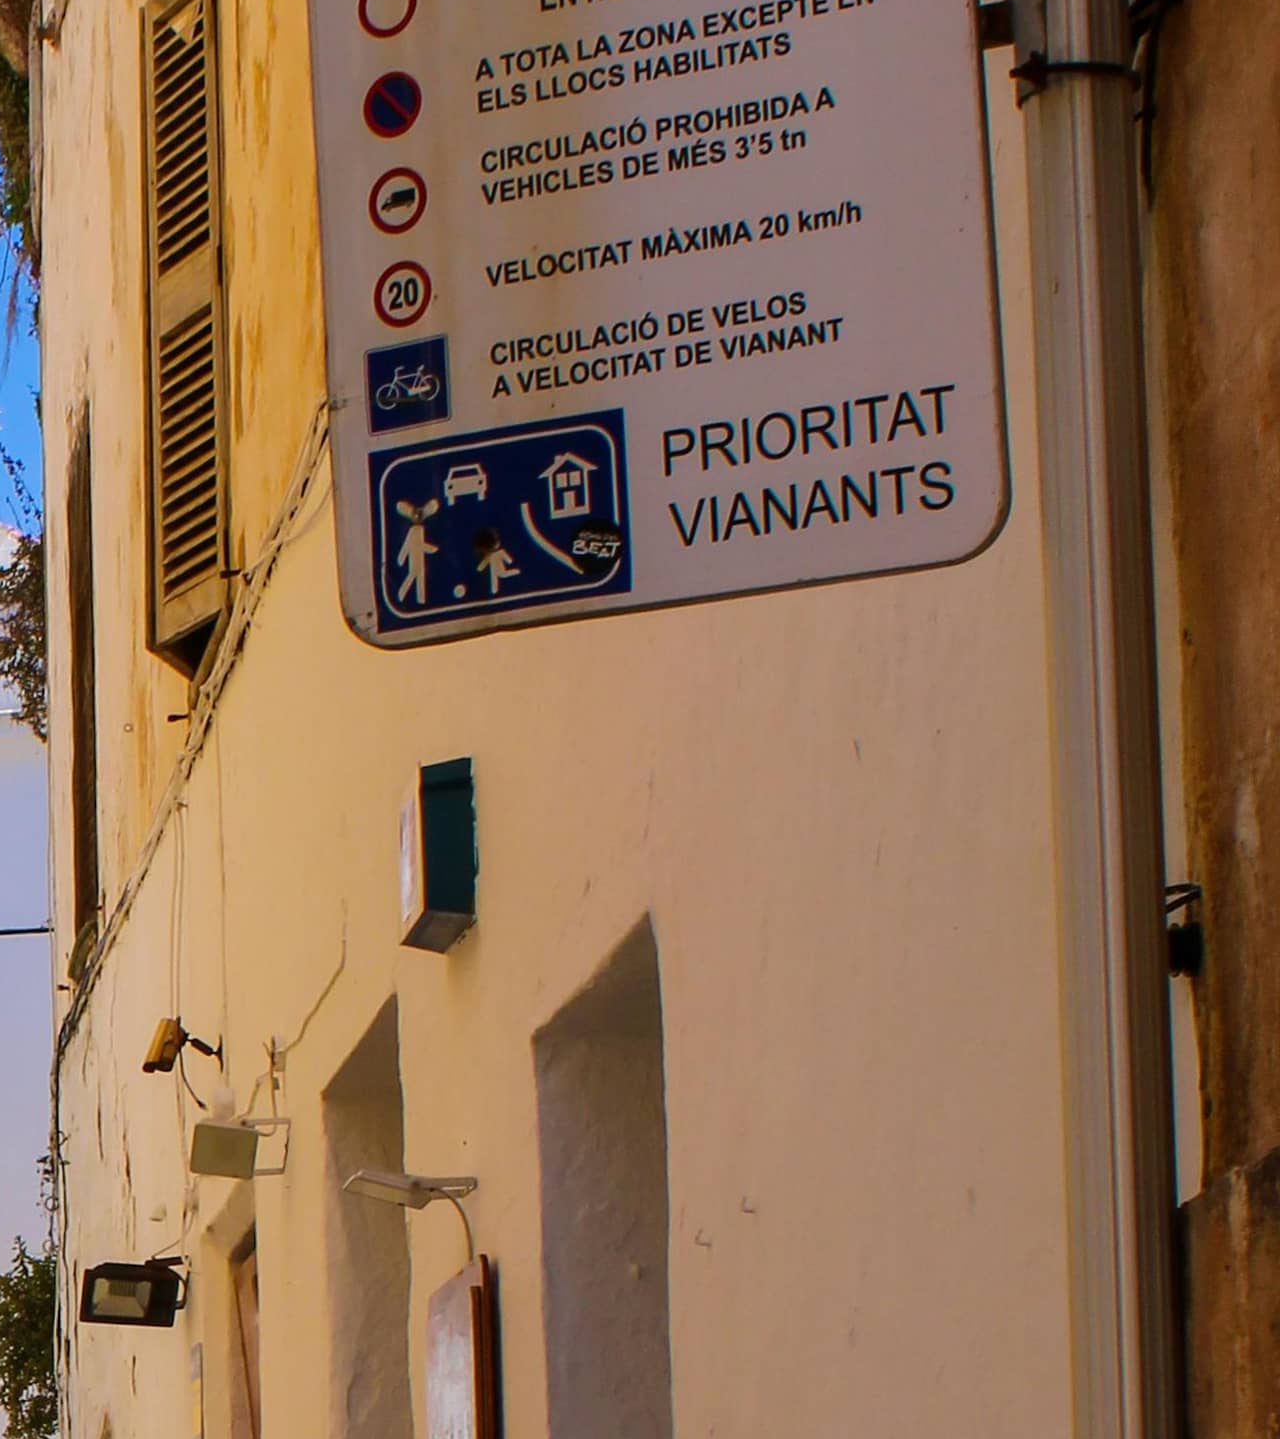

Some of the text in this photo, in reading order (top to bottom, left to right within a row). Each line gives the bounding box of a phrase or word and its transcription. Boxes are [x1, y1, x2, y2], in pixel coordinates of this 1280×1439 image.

[474, 57, 494, 83] A
[500, 42, 570, 76] TOTA
[576, 34, 613, 62] LA
[618, 18, 696, 54] ZONA
[477, 31, 792, 113] ELS LLOCS HABILITATS
[480, 85, 836, 174] CIRCULACIÓ PROHIBIDA A
[481, 159, 615, 206] VEHICLES
[622, 152, 660, 180] DE
[667, 137, 727, 172] MÉS
[780, 127, 808, 152] tn
[485, 201, 863, 288] VELOCITAT MÀXIMA 20 km/h
[386, 276, 421, 312] 20
[489, 290, 808, 366] CIRCULACIÓ DE VELOS
[491, 317, 845, 399] A VELOCITAT DE VIANANT
[662, 383, 956, 478] PRIORITAT
[668, 460, 956, 548] VIANANTS
